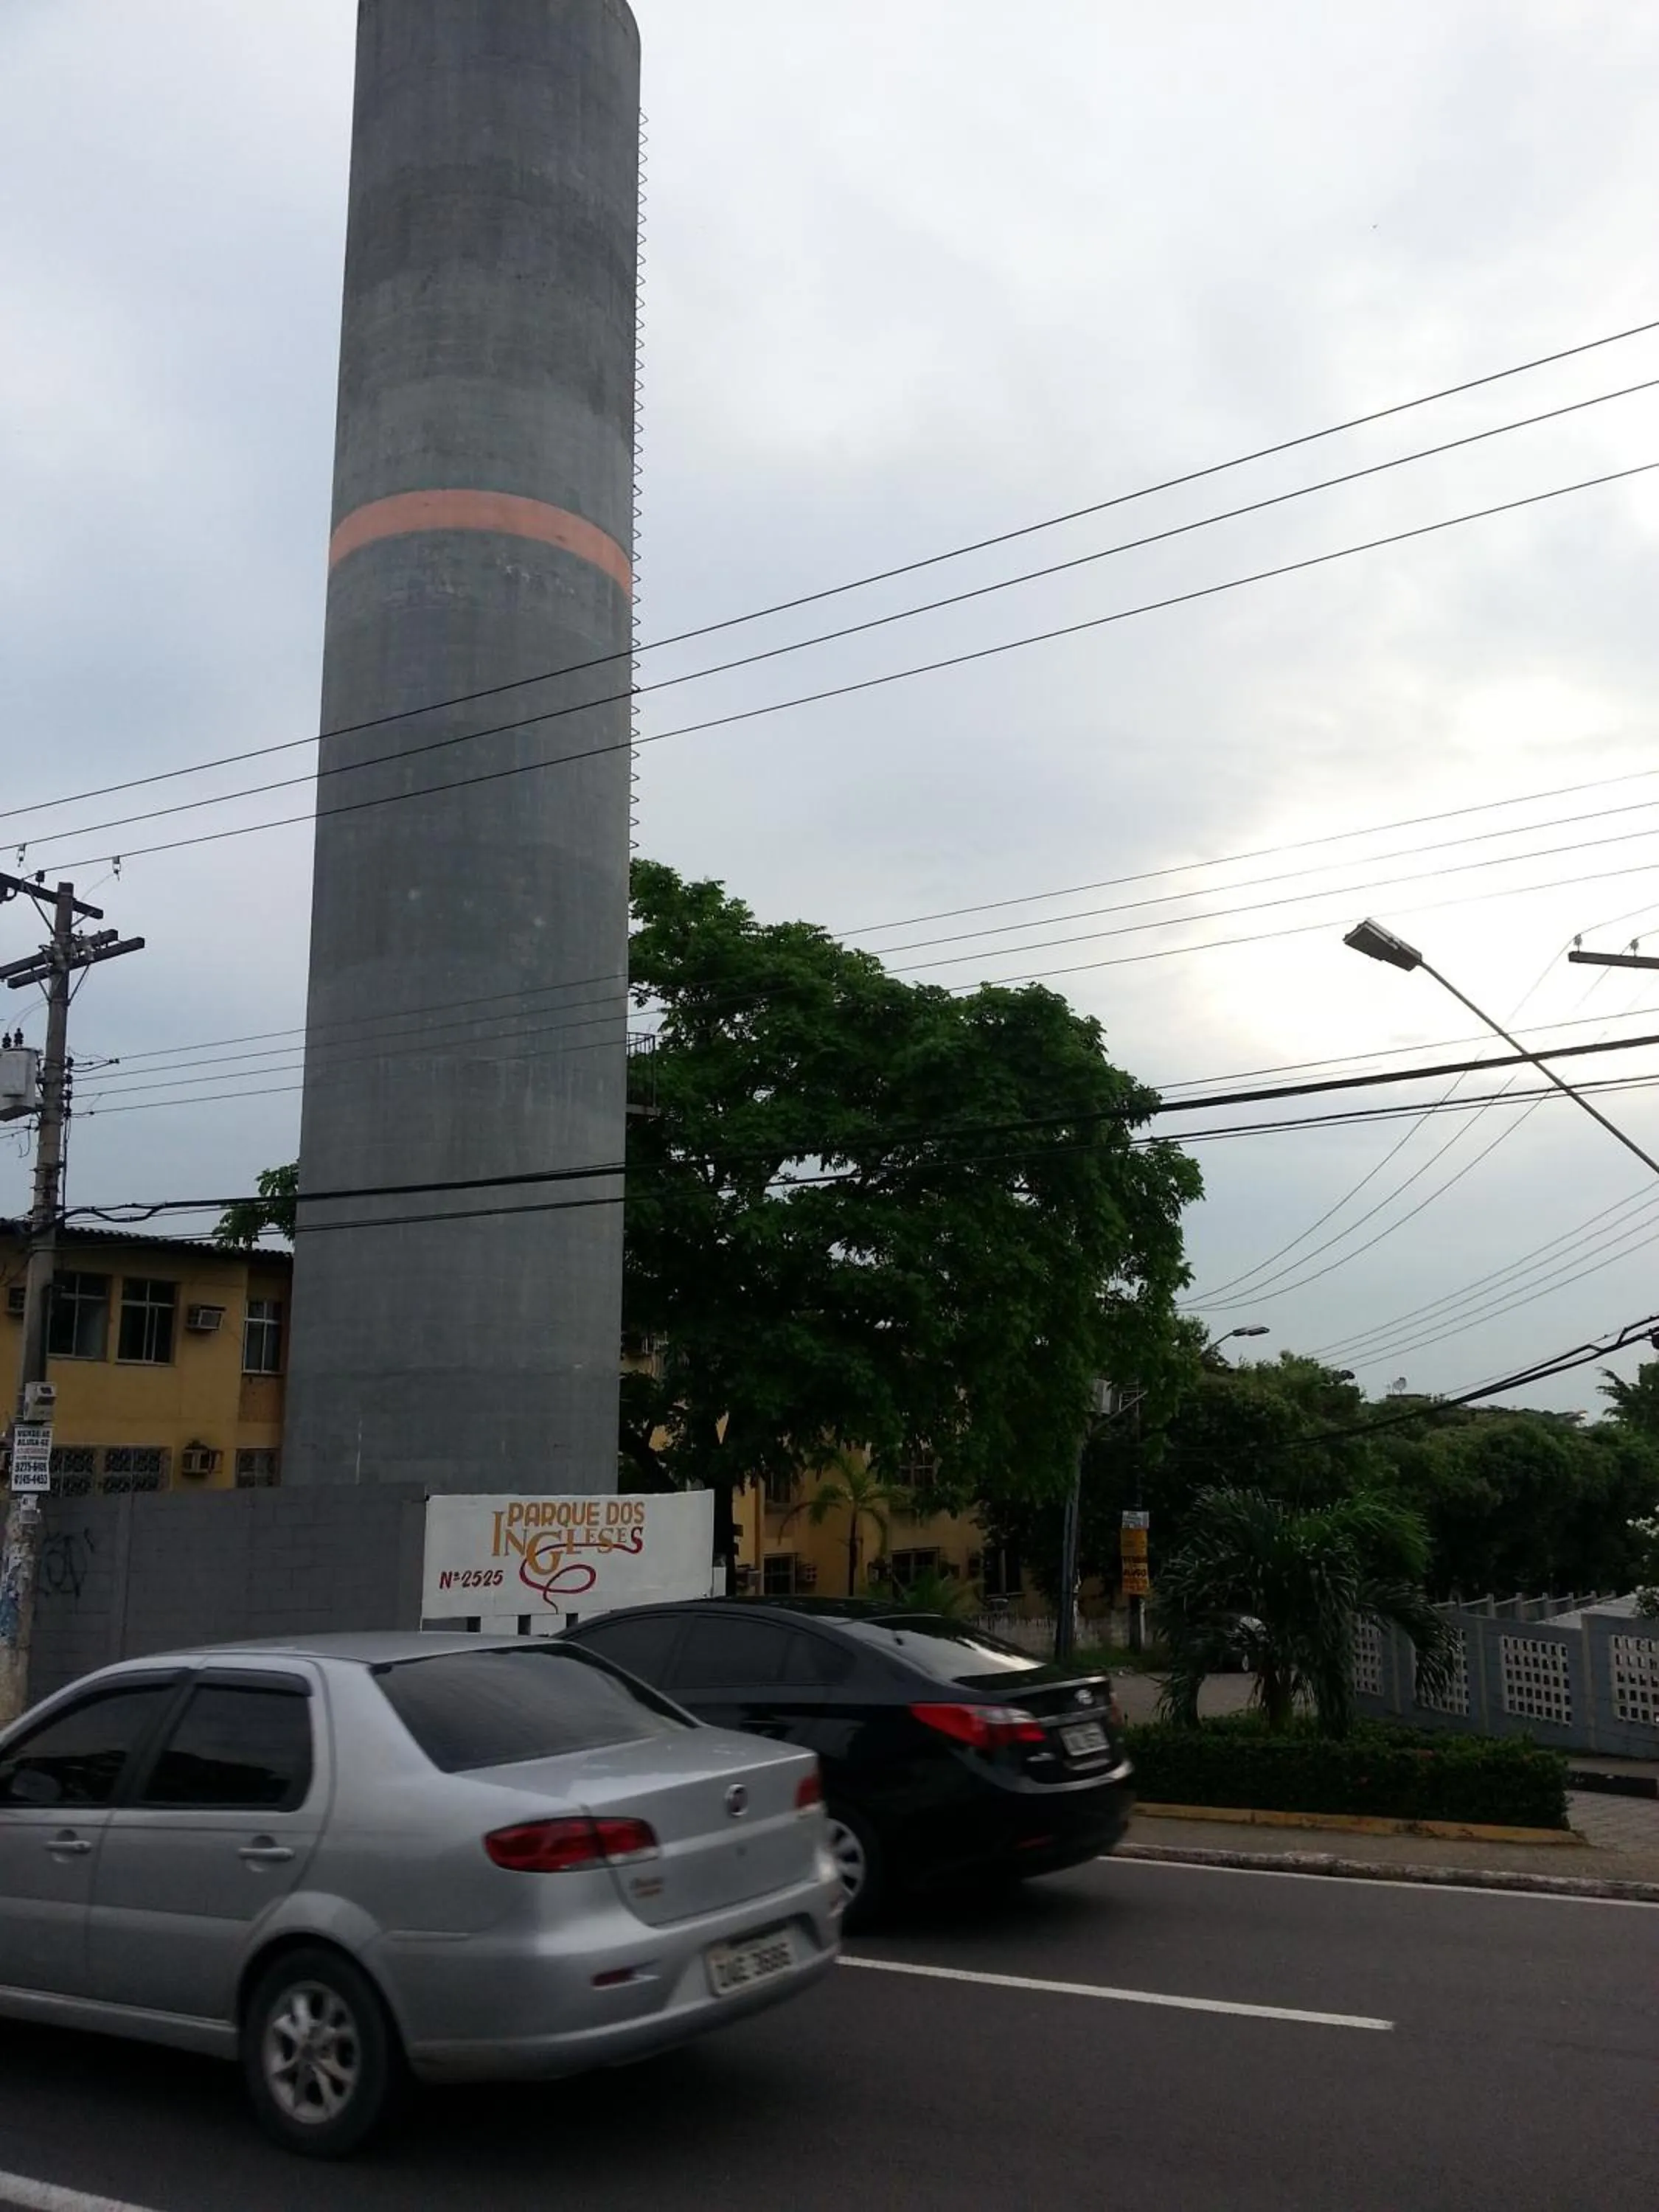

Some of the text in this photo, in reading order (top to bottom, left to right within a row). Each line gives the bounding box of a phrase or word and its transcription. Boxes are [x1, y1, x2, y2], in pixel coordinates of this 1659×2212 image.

[507, 1501, 645, 1527] PARQUE DOS
[491, 1510, 644, 1576] INGLESES
